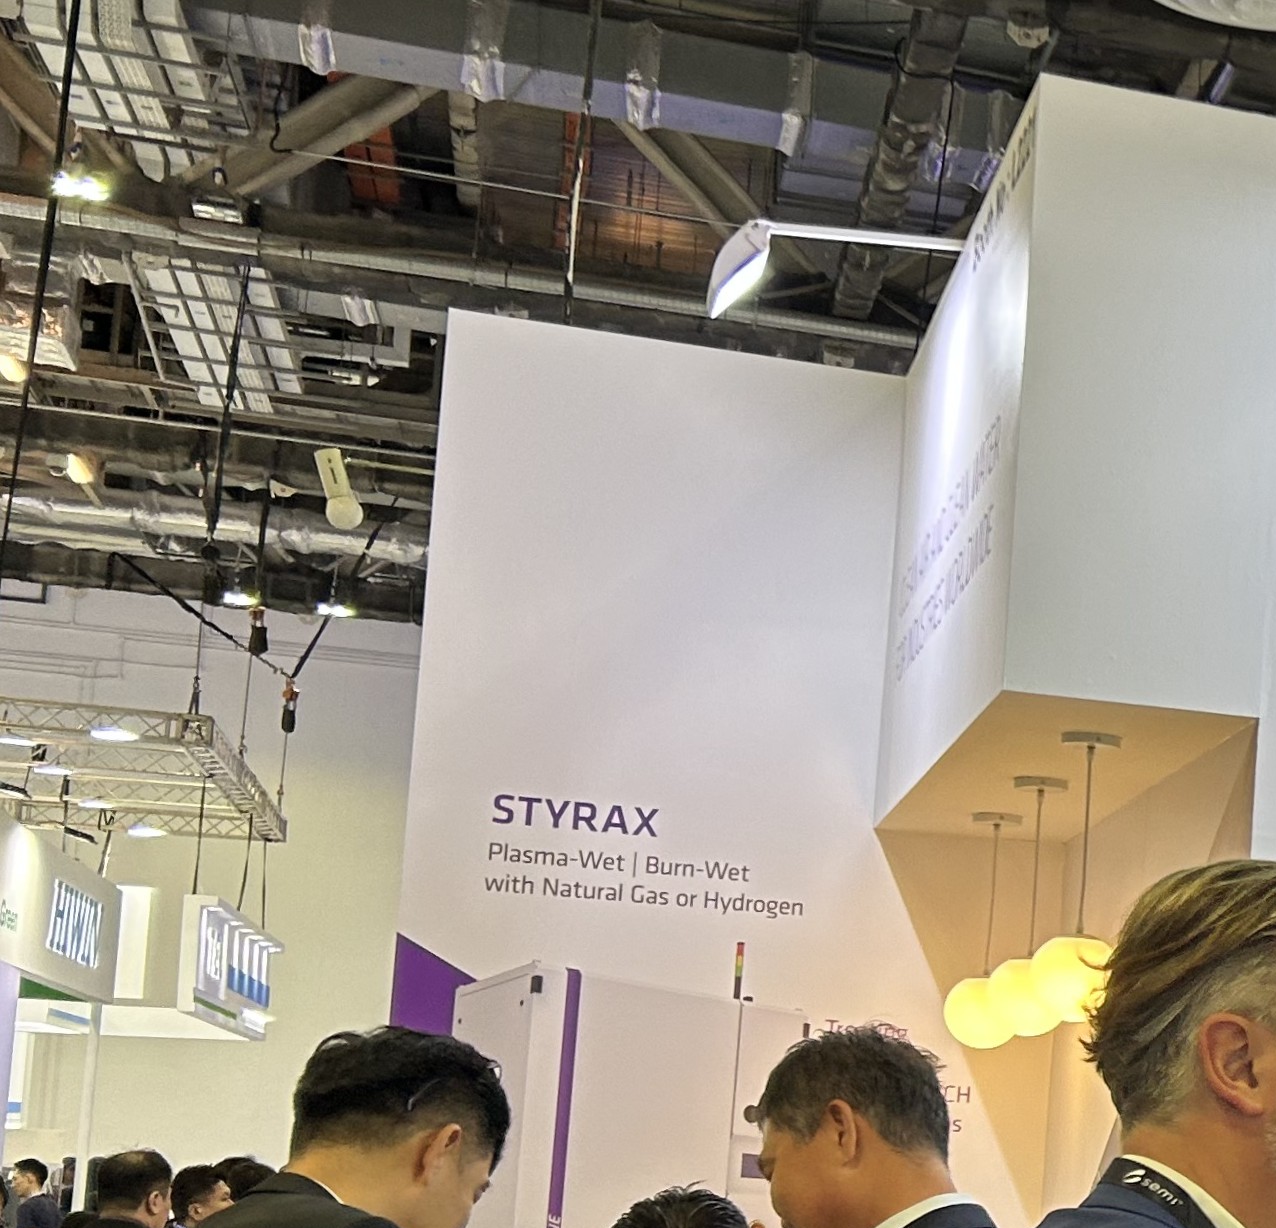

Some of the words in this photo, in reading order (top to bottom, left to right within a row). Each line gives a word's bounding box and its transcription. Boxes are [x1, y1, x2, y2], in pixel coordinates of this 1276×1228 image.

[491, 793, 660, 838] STYRAX
[487, 841, 626, 873] Plasma-Wet
[645, 855, 751, 883] Burn-Wet
[484, 874, 535, 896] with
[541, 877, 623, 902] Natural
[630, 884, 669, 906] Gas
[676, 890, 698, 908] or
[703, 891, 804, 919] Hydrogen
